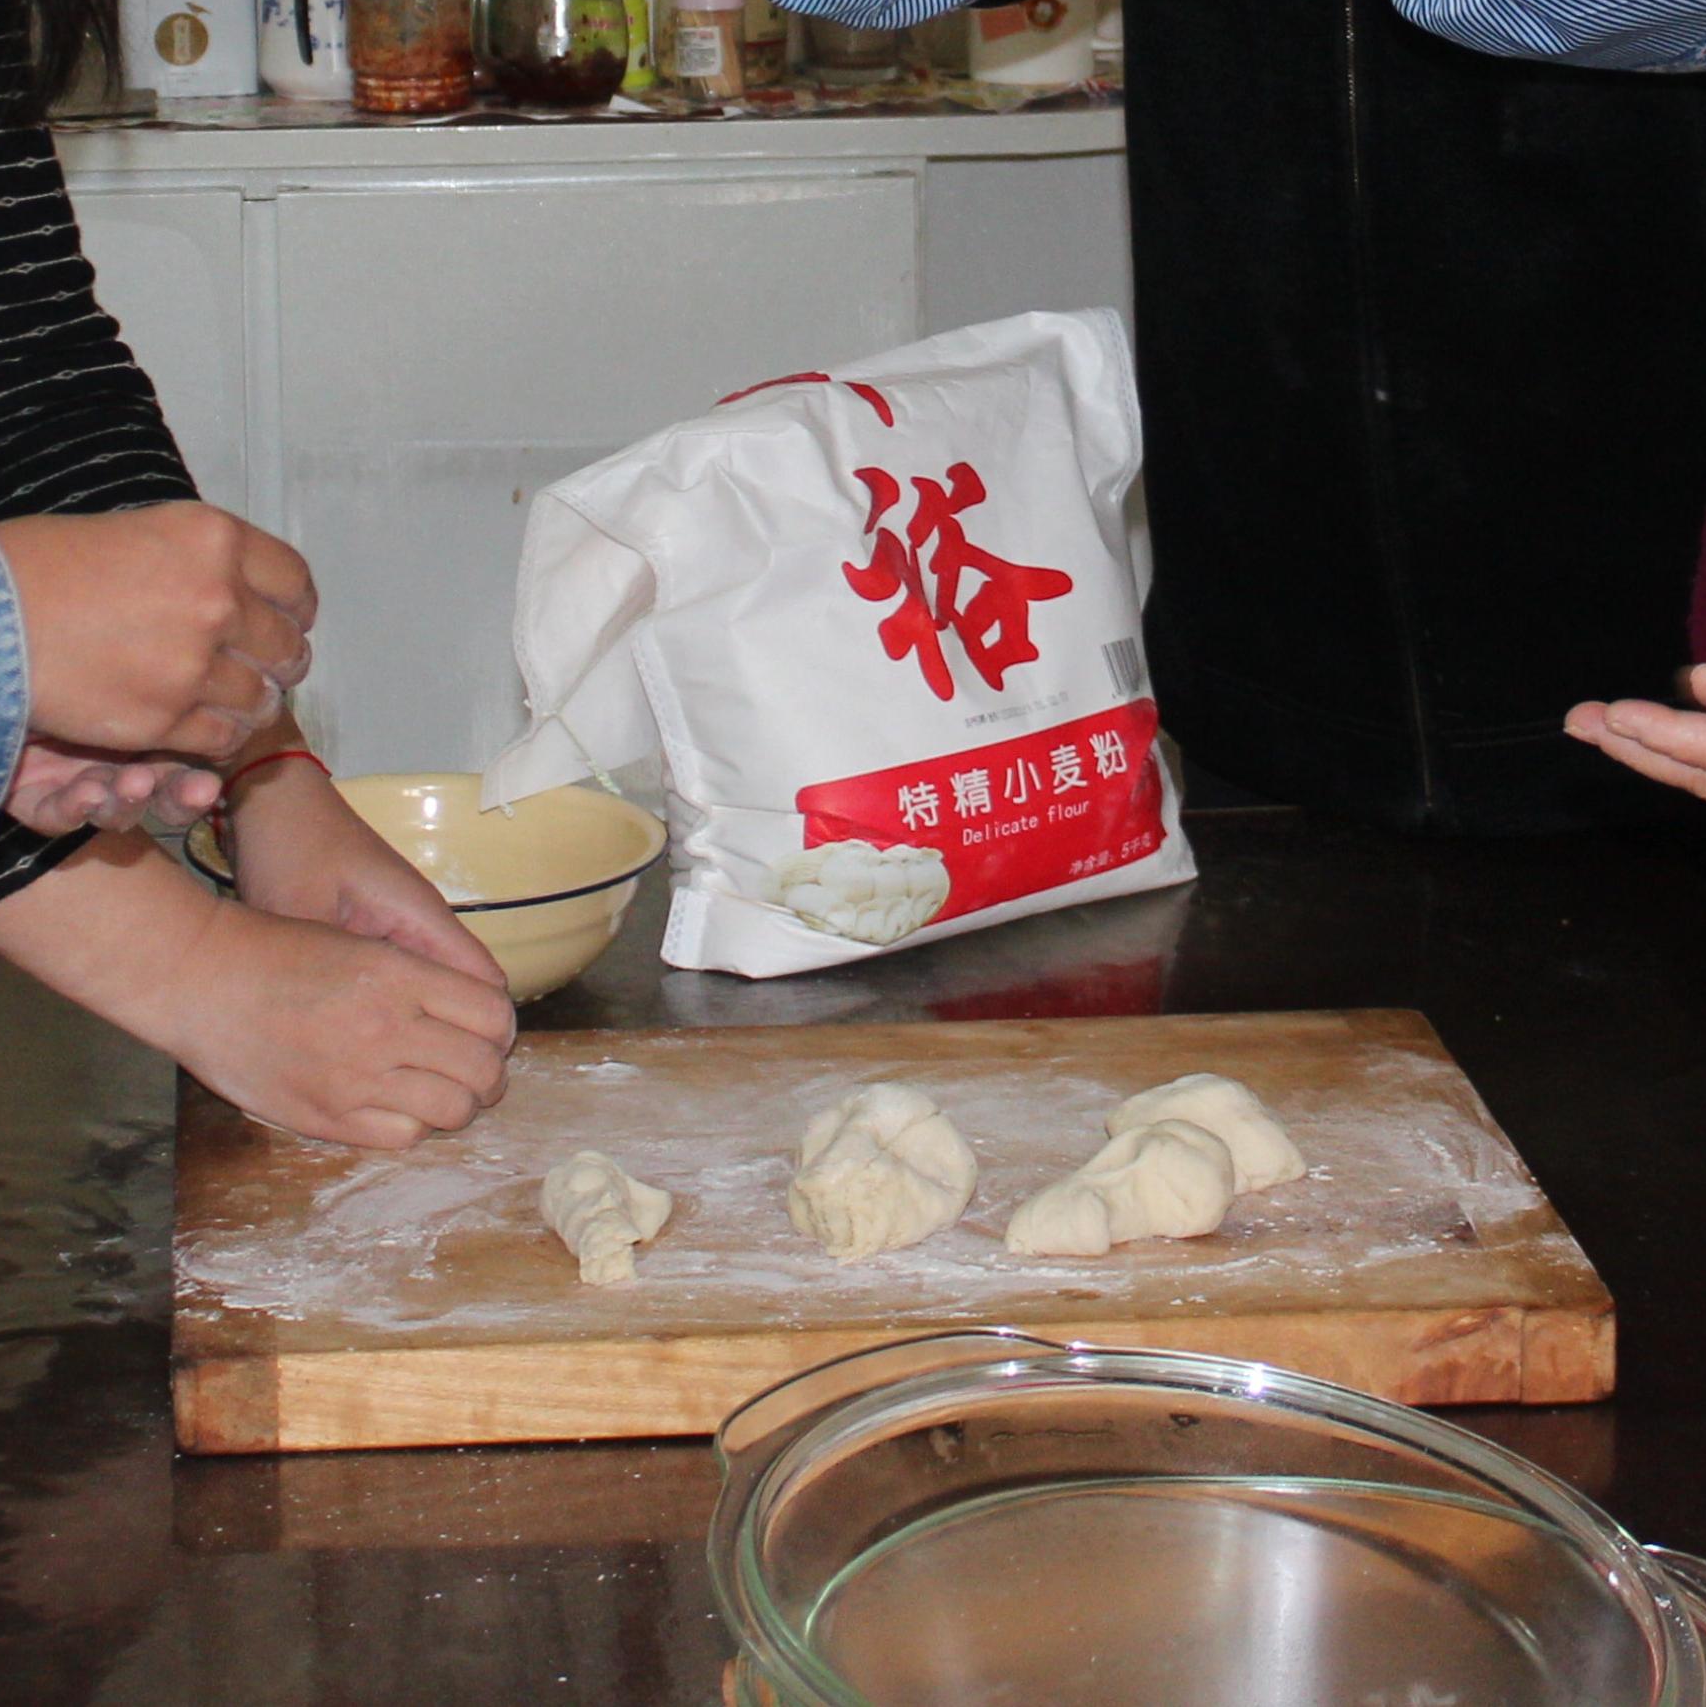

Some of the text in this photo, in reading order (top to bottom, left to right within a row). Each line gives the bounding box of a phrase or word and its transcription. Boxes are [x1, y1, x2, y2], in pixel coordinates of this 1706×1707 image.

[897, 730, 1129, 831] 特精小麦粉
[962, 799, 1091, 846] Delicate flour
